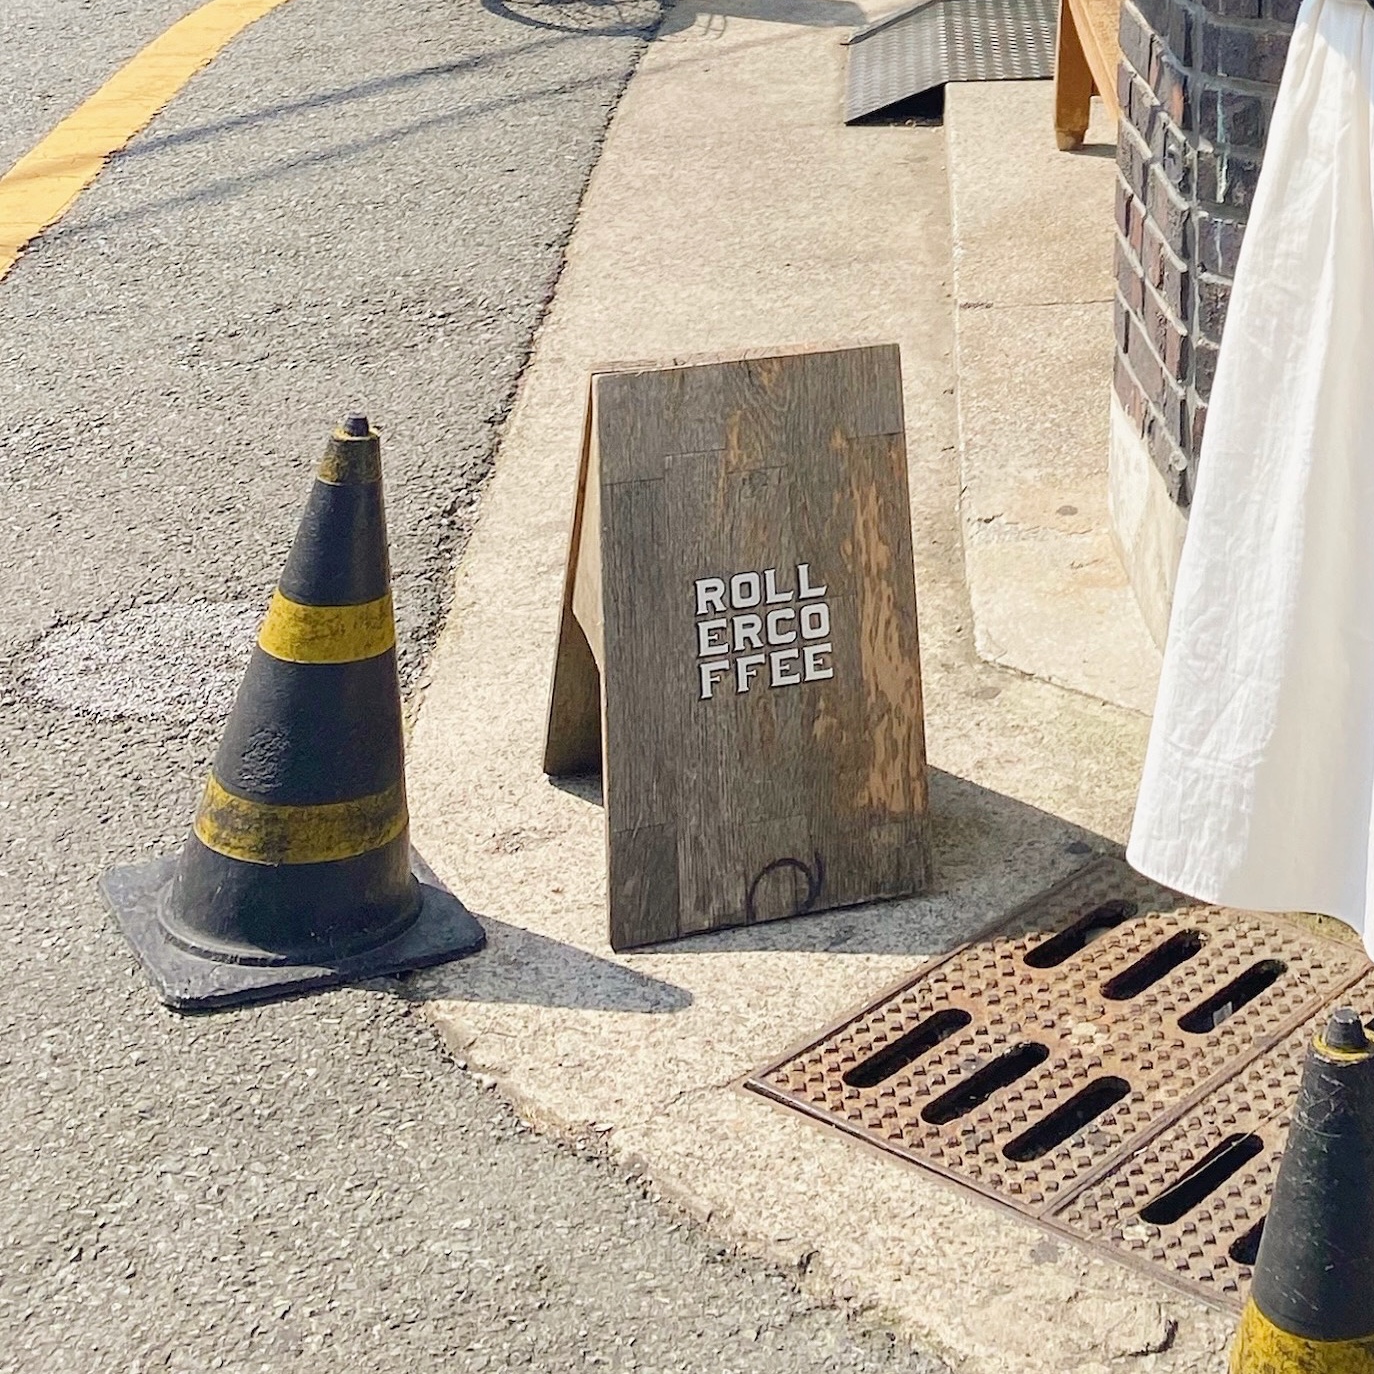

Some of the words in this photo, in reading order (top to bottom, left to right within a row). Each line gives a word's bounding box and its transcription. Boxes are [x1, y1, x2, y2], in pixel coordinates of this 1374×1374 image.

[695, 563, 828, 615] ROLL
[697, 602, 831, 657] ERCO
[699, 643, 834, 700] FFEE
